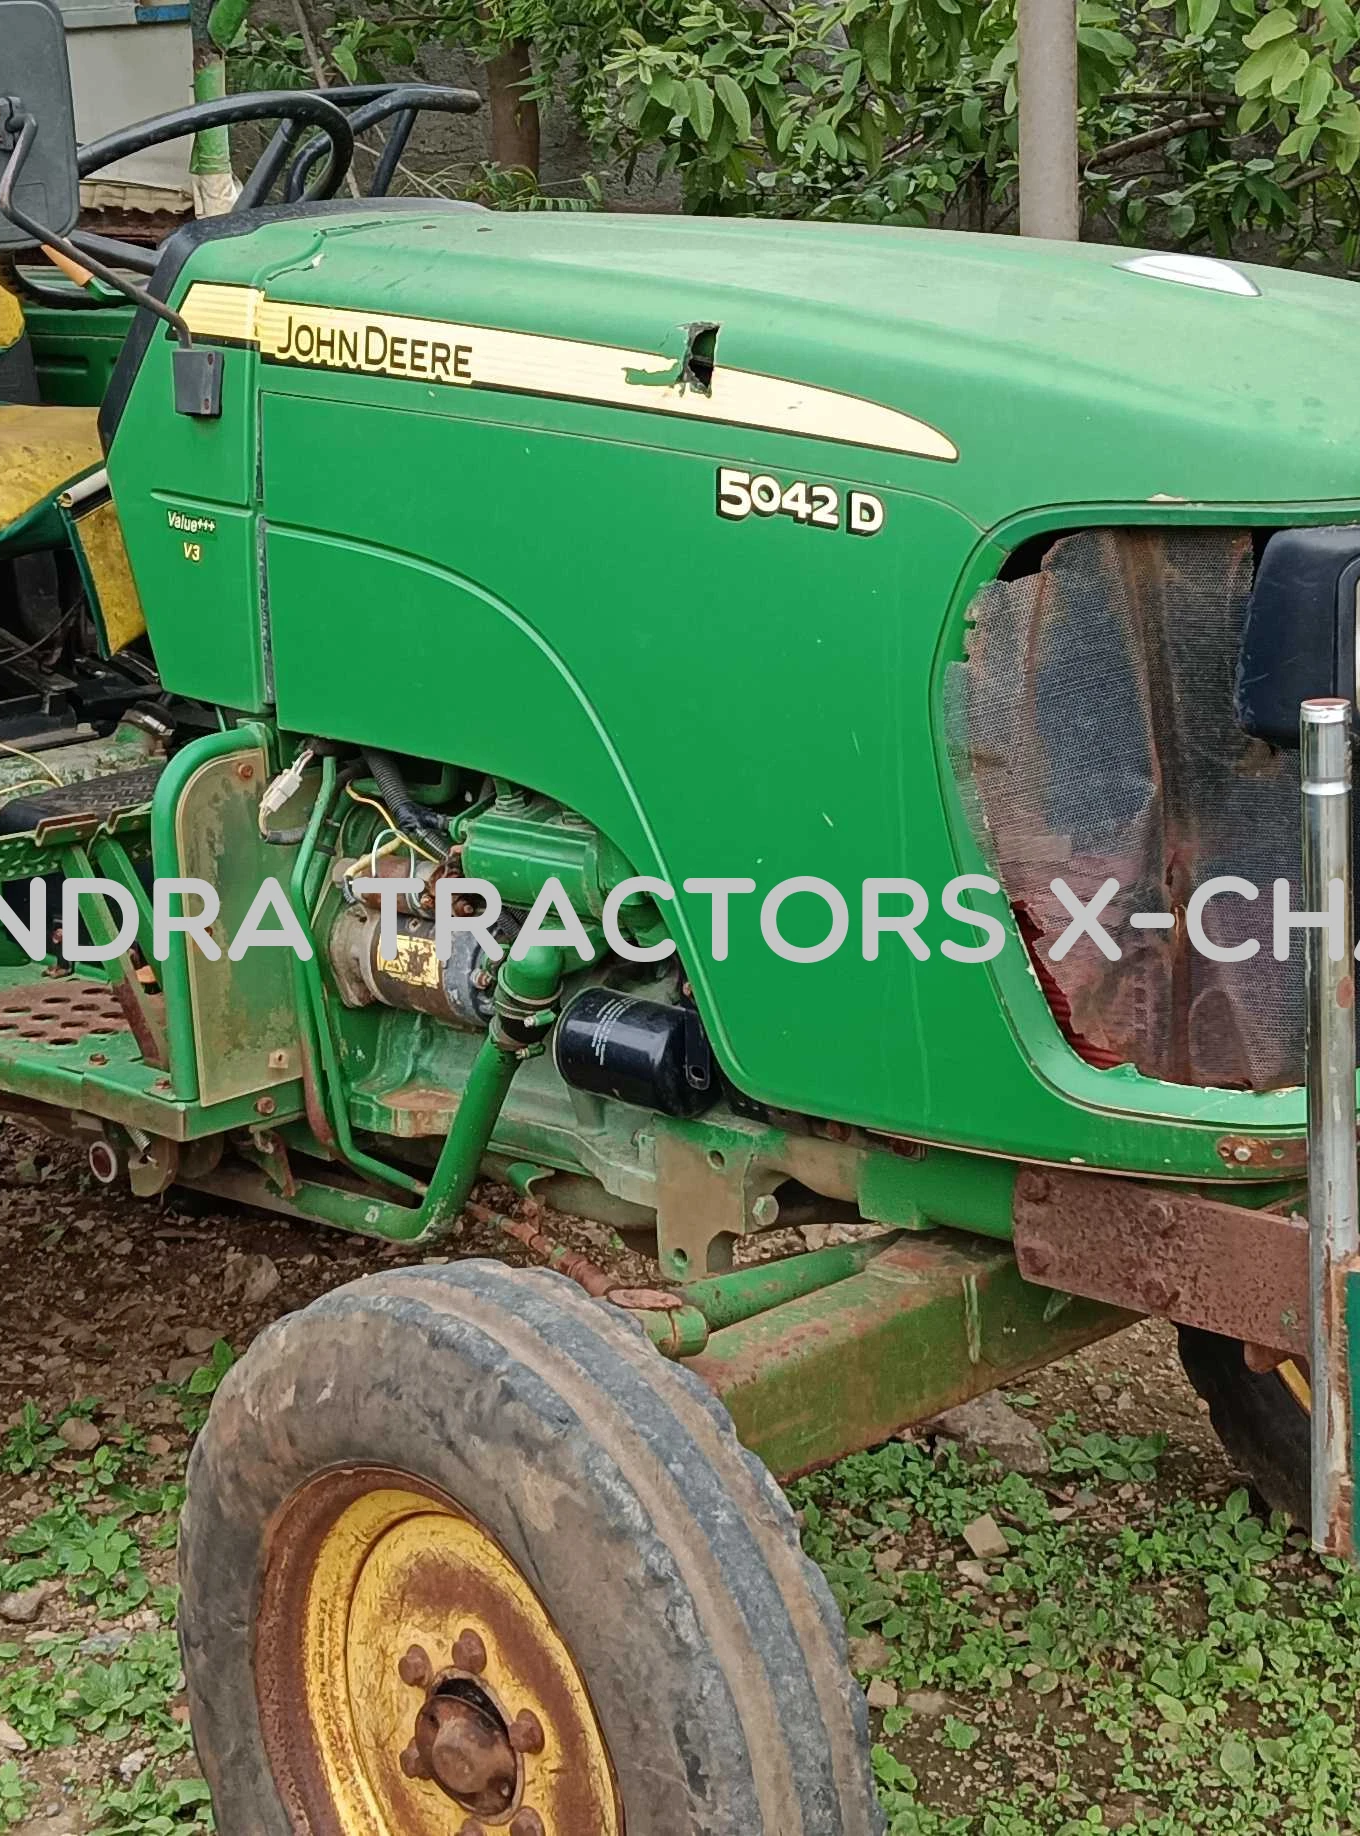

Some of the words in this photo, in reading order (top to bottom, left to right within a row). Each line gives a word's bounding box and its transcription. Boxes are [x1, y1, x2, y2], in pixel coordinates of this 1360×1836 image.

[277, 315, 358, 363] JOHN
[365, 325, 473, 379] DEERE
[716, 466, 839, 530] 5042
[846, 490, 884, 537] D
[183, 541, 201, 562] V3
